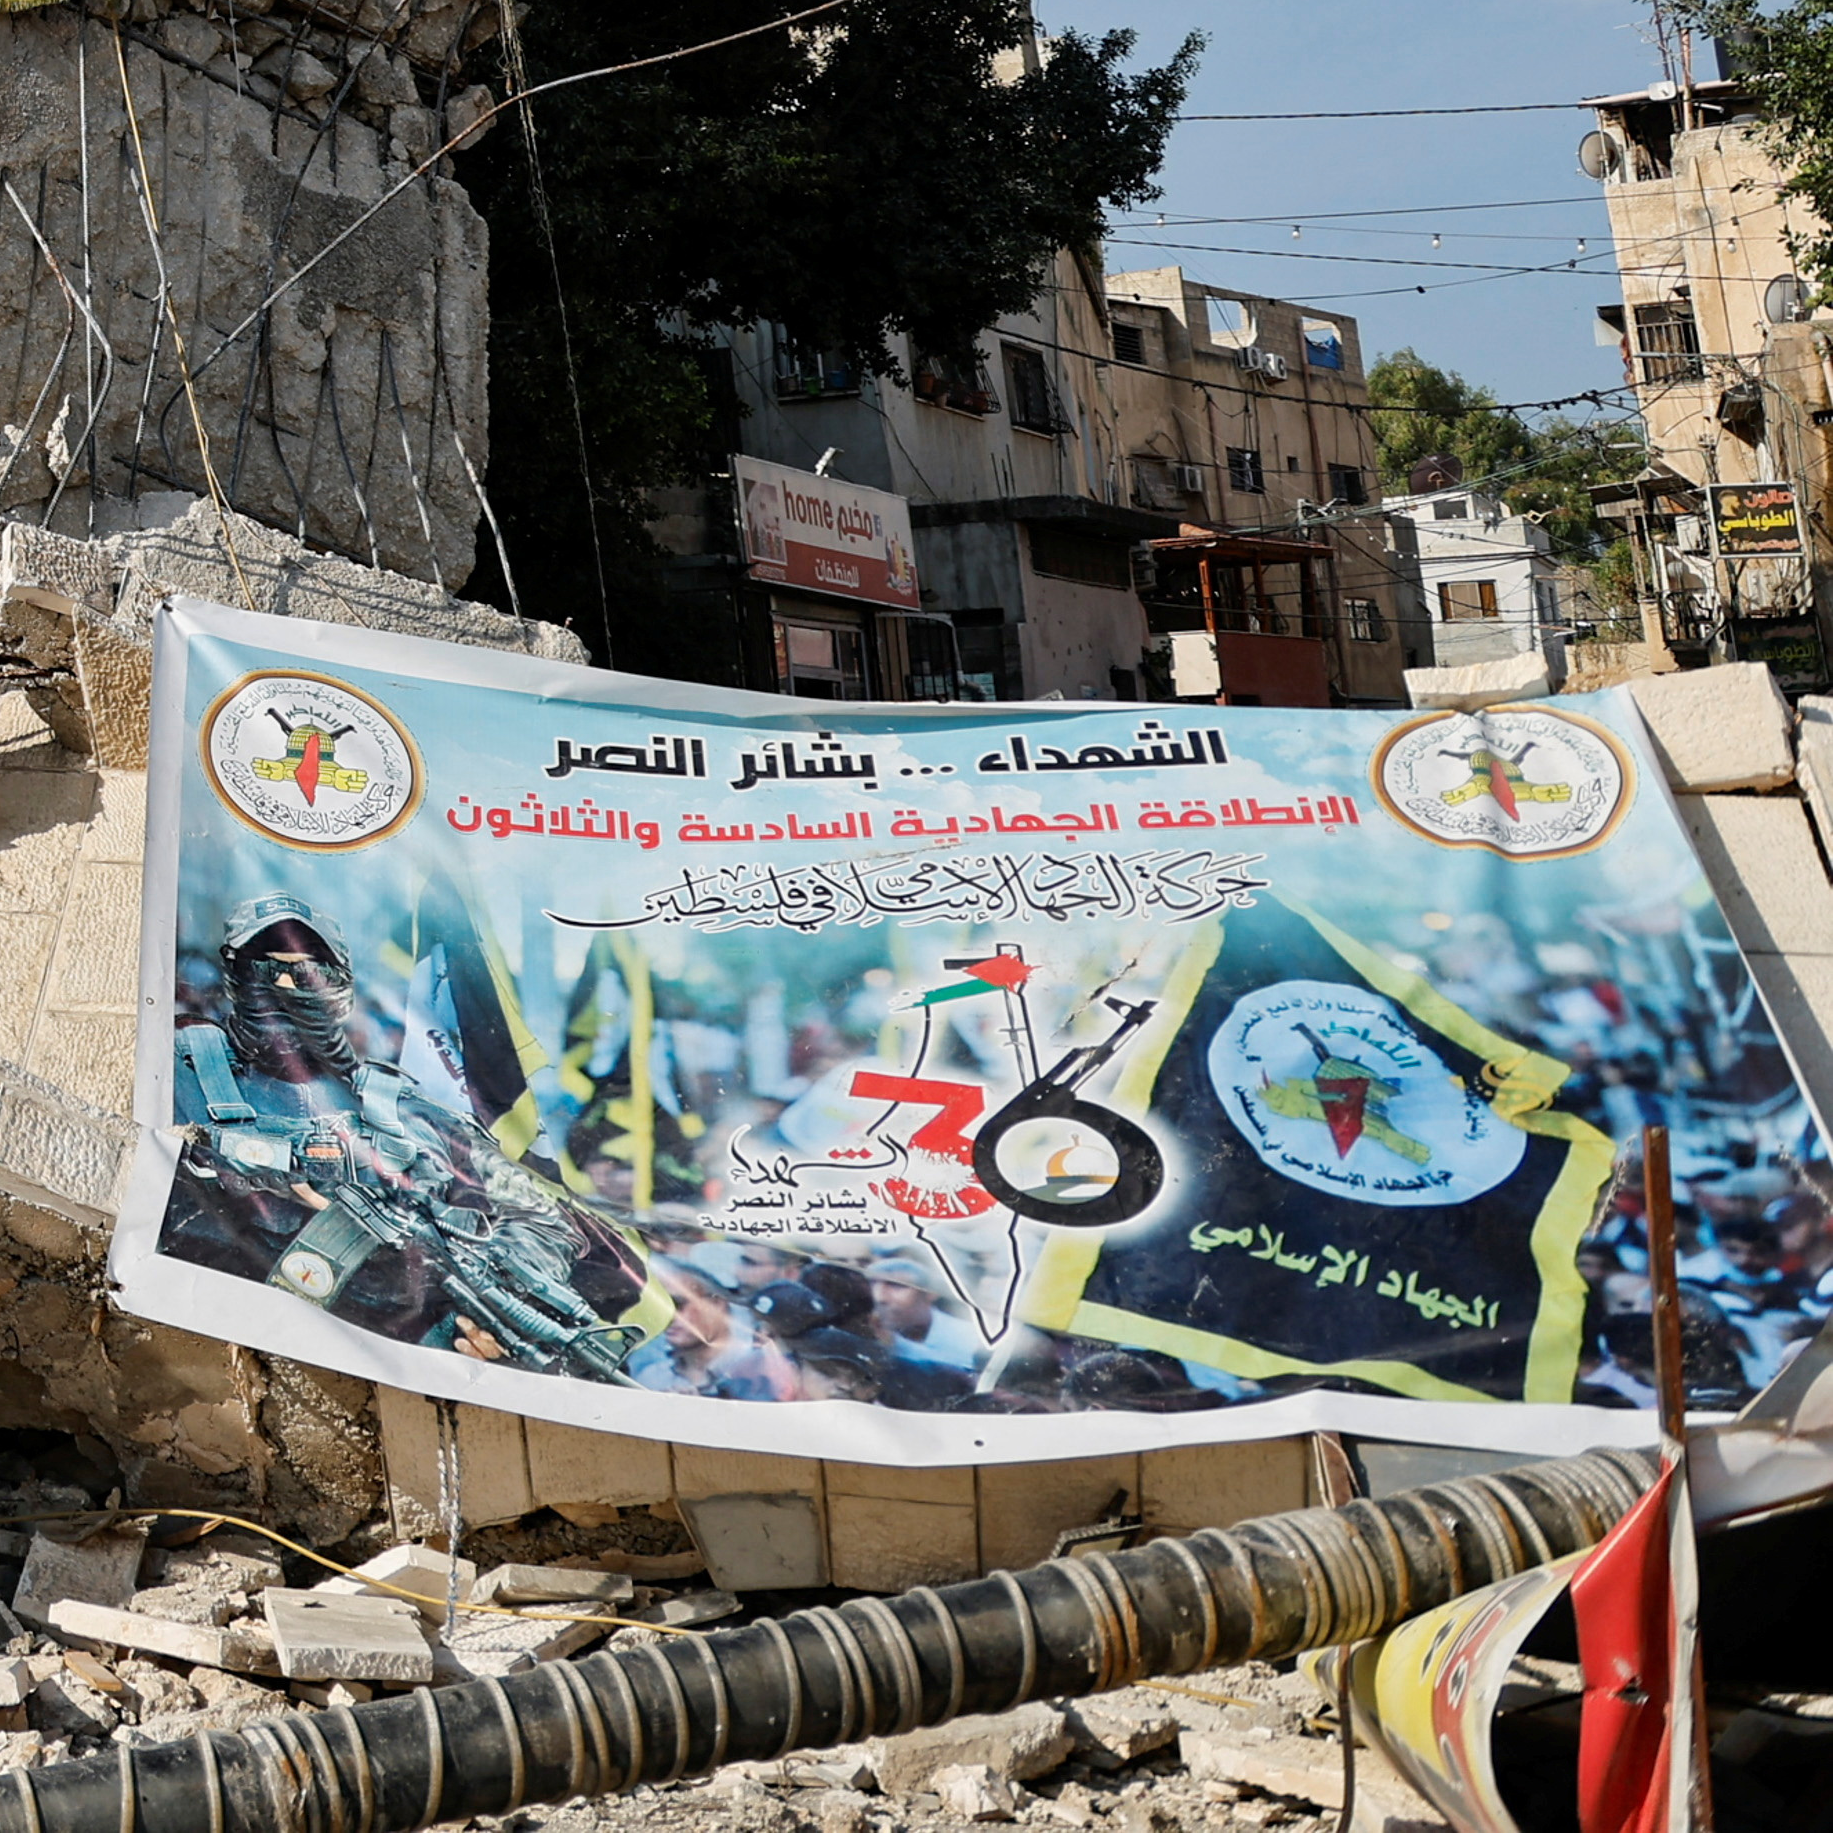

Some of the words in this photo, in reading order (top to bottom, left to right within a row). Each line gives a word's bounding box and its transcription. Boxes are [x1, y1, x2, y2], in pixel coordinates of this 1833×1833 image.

[782, 479, 834, 531] home
[1743, 489, 1794, 509] صالون
[837, 500, 874, 544] مخيم
[1718, 509, 1795, 536] الطوباسي
[544, 733, 708, 781] النصر
[732, 730, 877, 794] بشائر
[977, 718, 1229, 774] الشهداء
[445, 793, 663, 853] والثلاثون
[678, 808, 871, 845] السادسة
[889, 804, 1119, 845] الجهادية
[1138, 793, 1361, 838] الإنطلاقة
[1141, 854, 1275, 926] حركة
[849, 1051, 1165, 1228] 36
[727, 1190, 795, 1212] النصر
[806, 1189, 868, 1213] بشائر
[700, 1215, 792, 1238] الجهادية
[795, 1216, 897, 1234] الانطلاقة
[1188, 1220, 1371, 1289] الإسلامي
[1376, 1269, 1501, 1330] الجهاد
